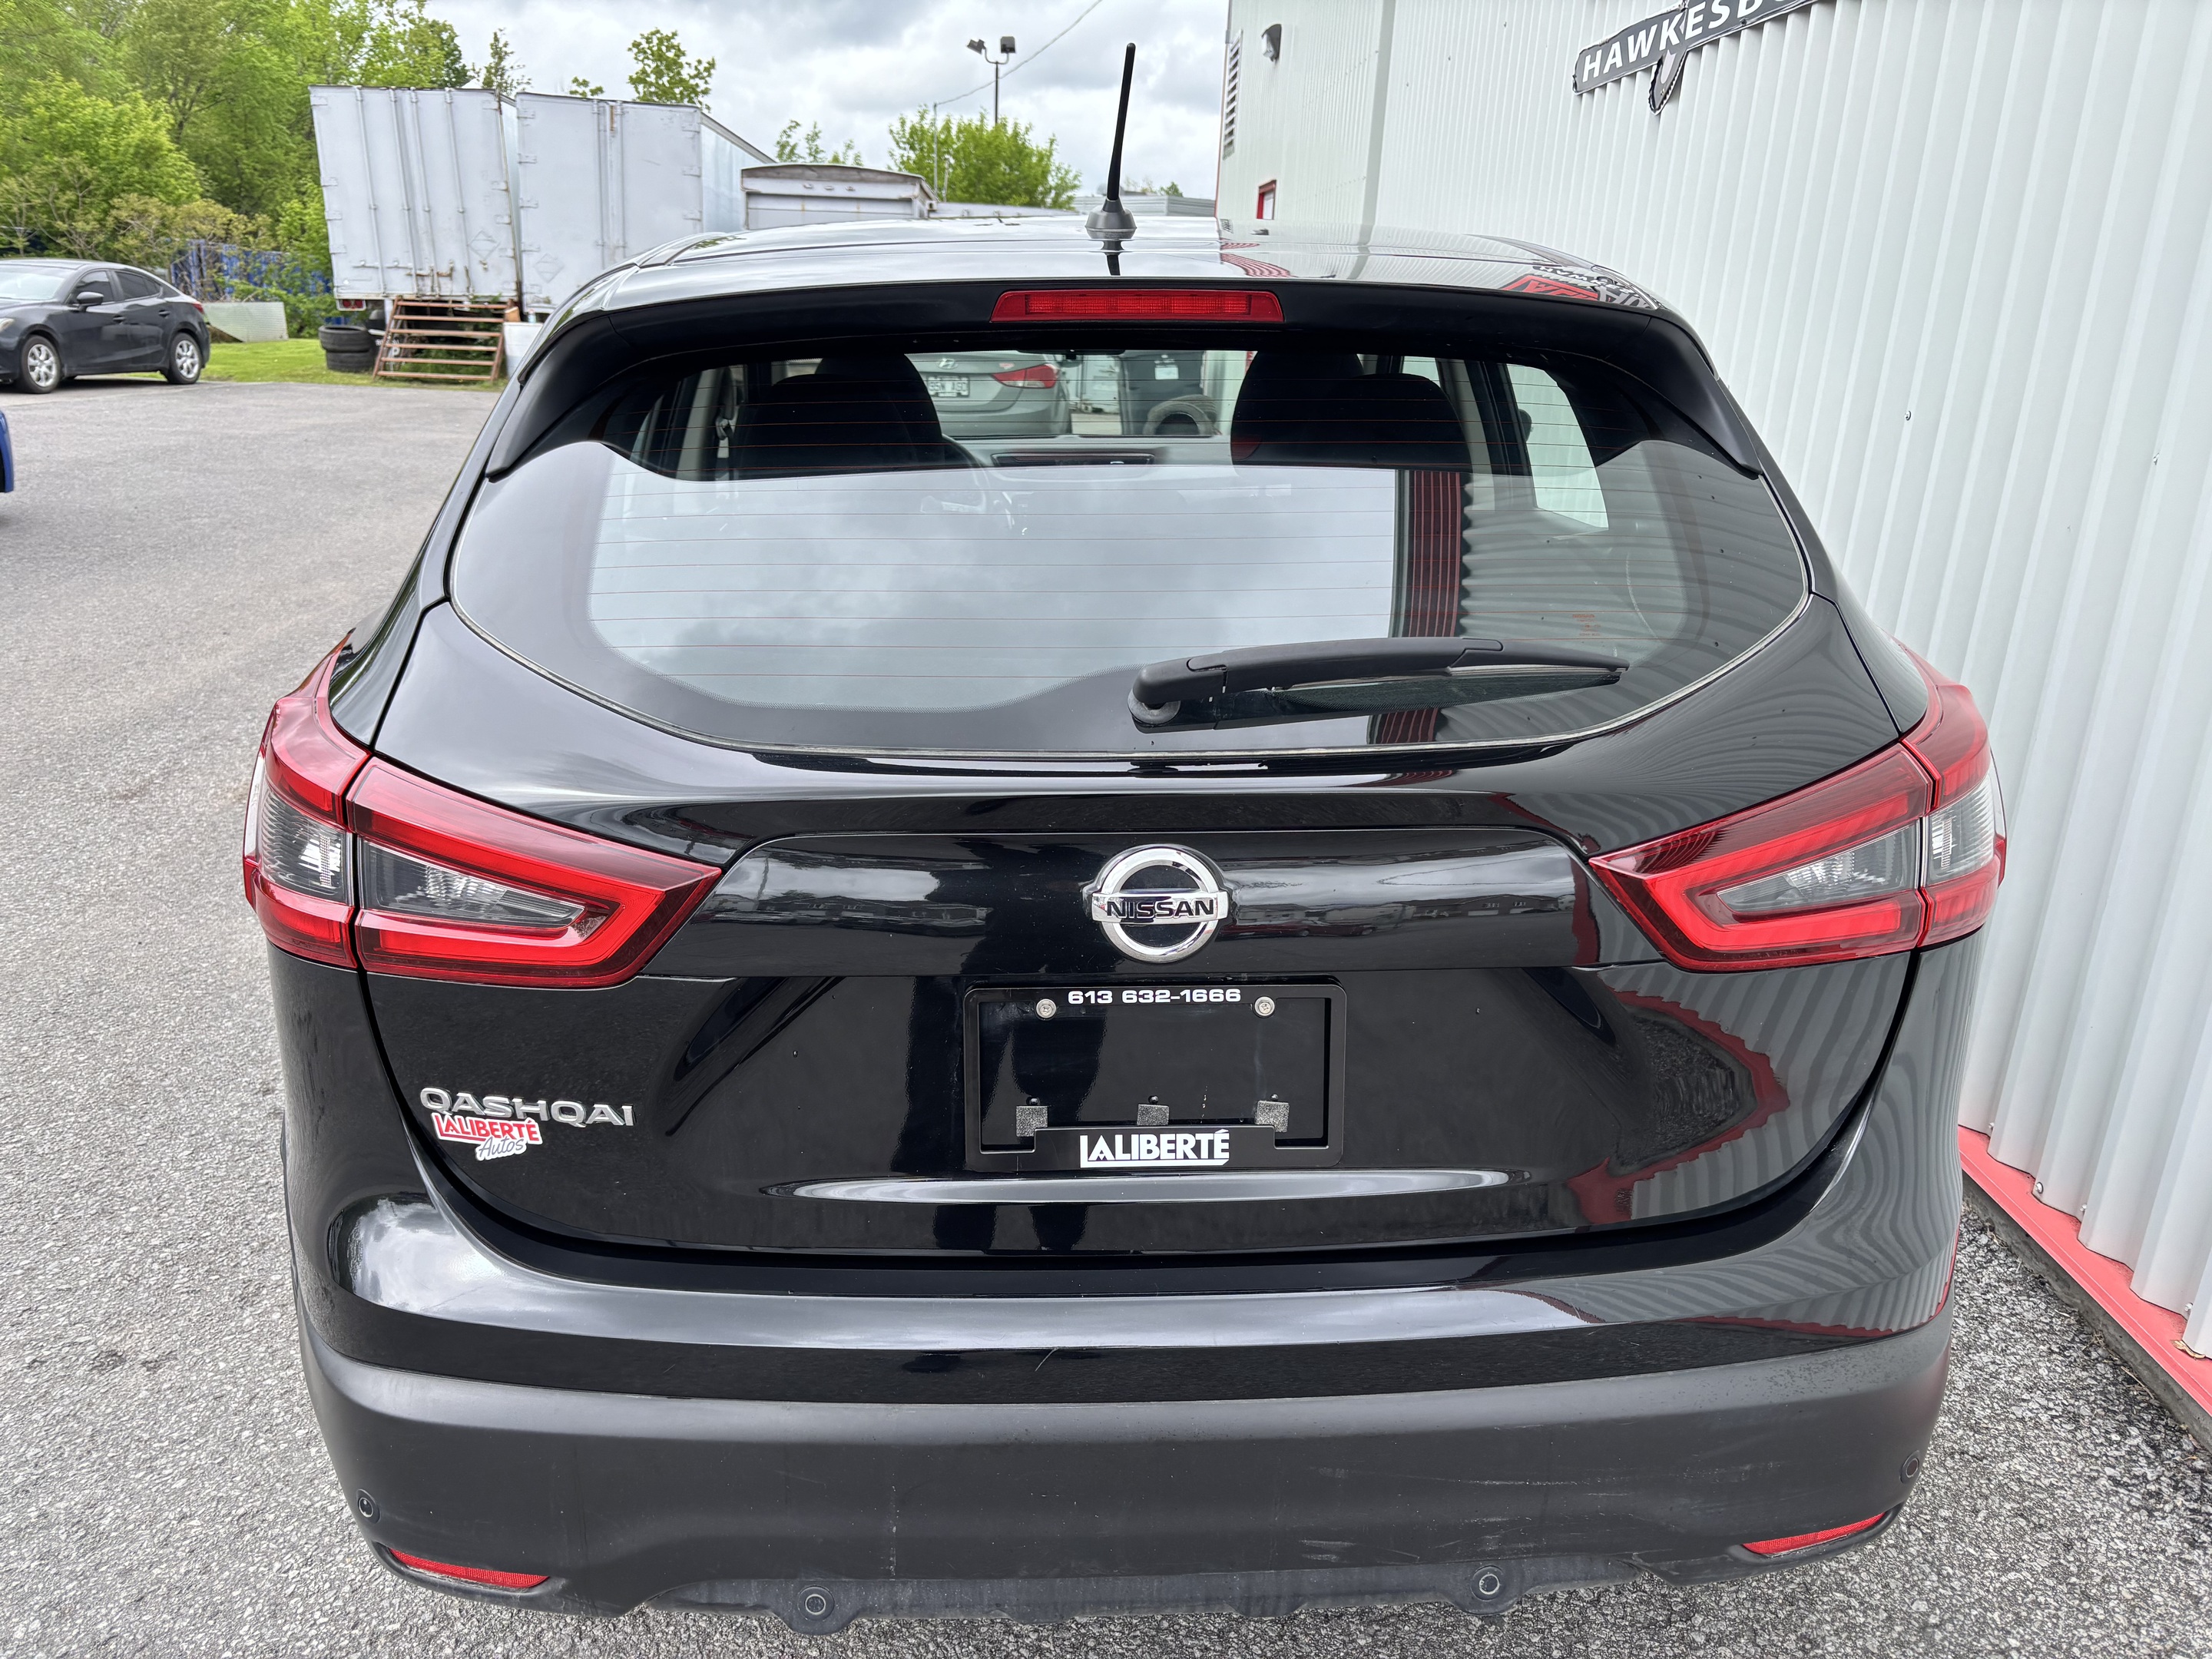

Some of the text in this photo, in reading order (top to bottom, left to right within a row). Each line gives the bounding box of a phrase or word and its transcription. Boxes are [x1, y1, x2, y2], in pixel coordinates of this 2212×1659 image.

[1107, 899, 1214, 919] NISSAN
[1068, 988, 1241, 1005] 613 632-1666
[420, 1087, 636, 1128] QASHQAI
[432, 1113, 540, 1142] LALIBERTÉ
[478, 1135, 524, 1157] Autos
[1080, 1128, 1229, 1168] LALIBERTÉ
